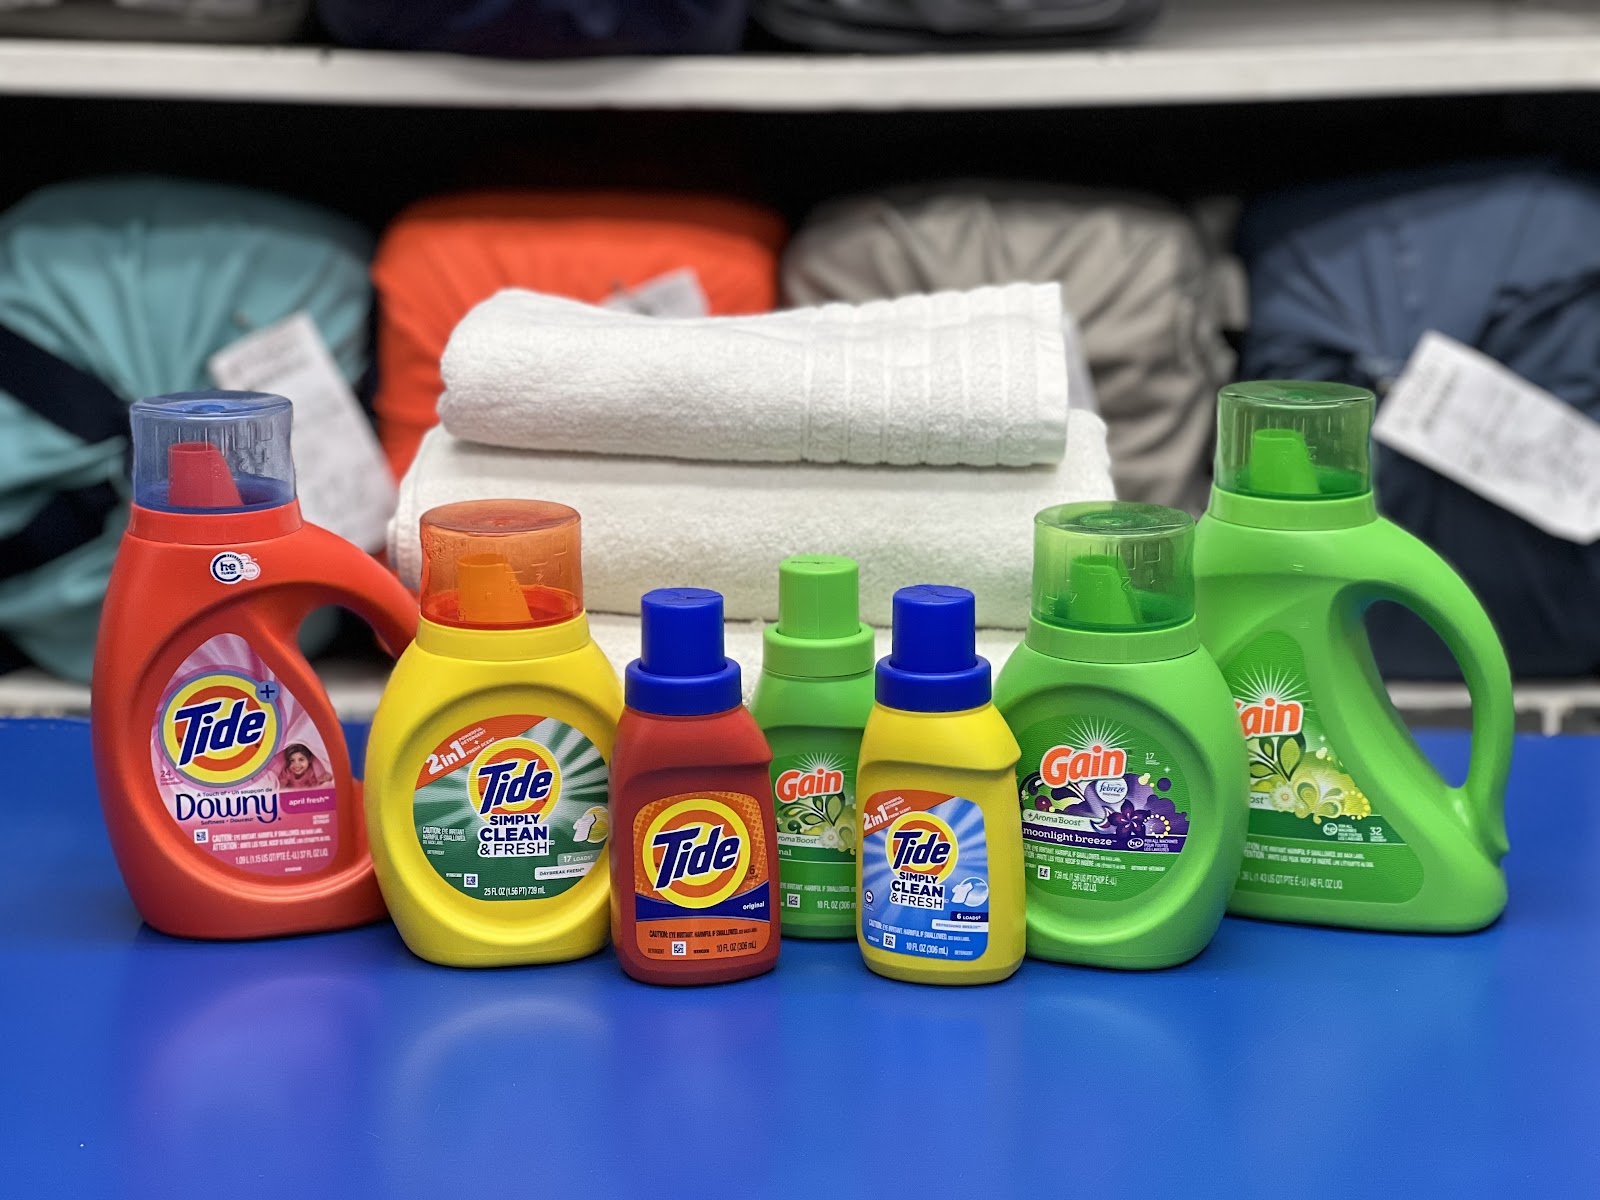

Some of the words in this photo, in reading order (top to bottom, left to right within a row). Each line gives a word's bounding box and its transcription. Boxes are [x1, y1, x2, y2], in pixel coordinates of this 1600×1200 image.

[1236, 697, 1301, 739] ain
[174, 699, 266, 768] Tide
[1145, 752, 1155, 760] 17
[1041, 744, 1126, 787] Gain
[160, 770, 171, 778] 24
[478, 760, 553, 815] Tide
[775, 768, 842, 802] Gain
[1099, 781, 1126, 793] febreze
[175, 793, 278, 824] Downy
[288, 797, 305, 807] april
[489, 814, 540, 826] SIMPLY
[479, 826, 548, 842] CLEAN
[1023, 827, 1073, 843] moonlight
[1369, 826, 1383, 836] 32
[479, 844, 490, 855] &
[493, 842, 548, 855] FRESH
[893, 831, 951, 870] Tide
[563, 855, 572, 863] 17
[653, 825, 740, 890] Tide
[899, 871, 939, 885] SIMPLY
[483, 887, 491, 896] 25
[491, 887, 498, 896] FL
[498, 887, 506, 896] OZ
[527, 886, 538, 895] 739
[891, 880, 944, 898] CLEAN
[742, 901, 765, 911] original
[890, 892, 899, 903] &
[900, 893, 943, 909] FRESH
